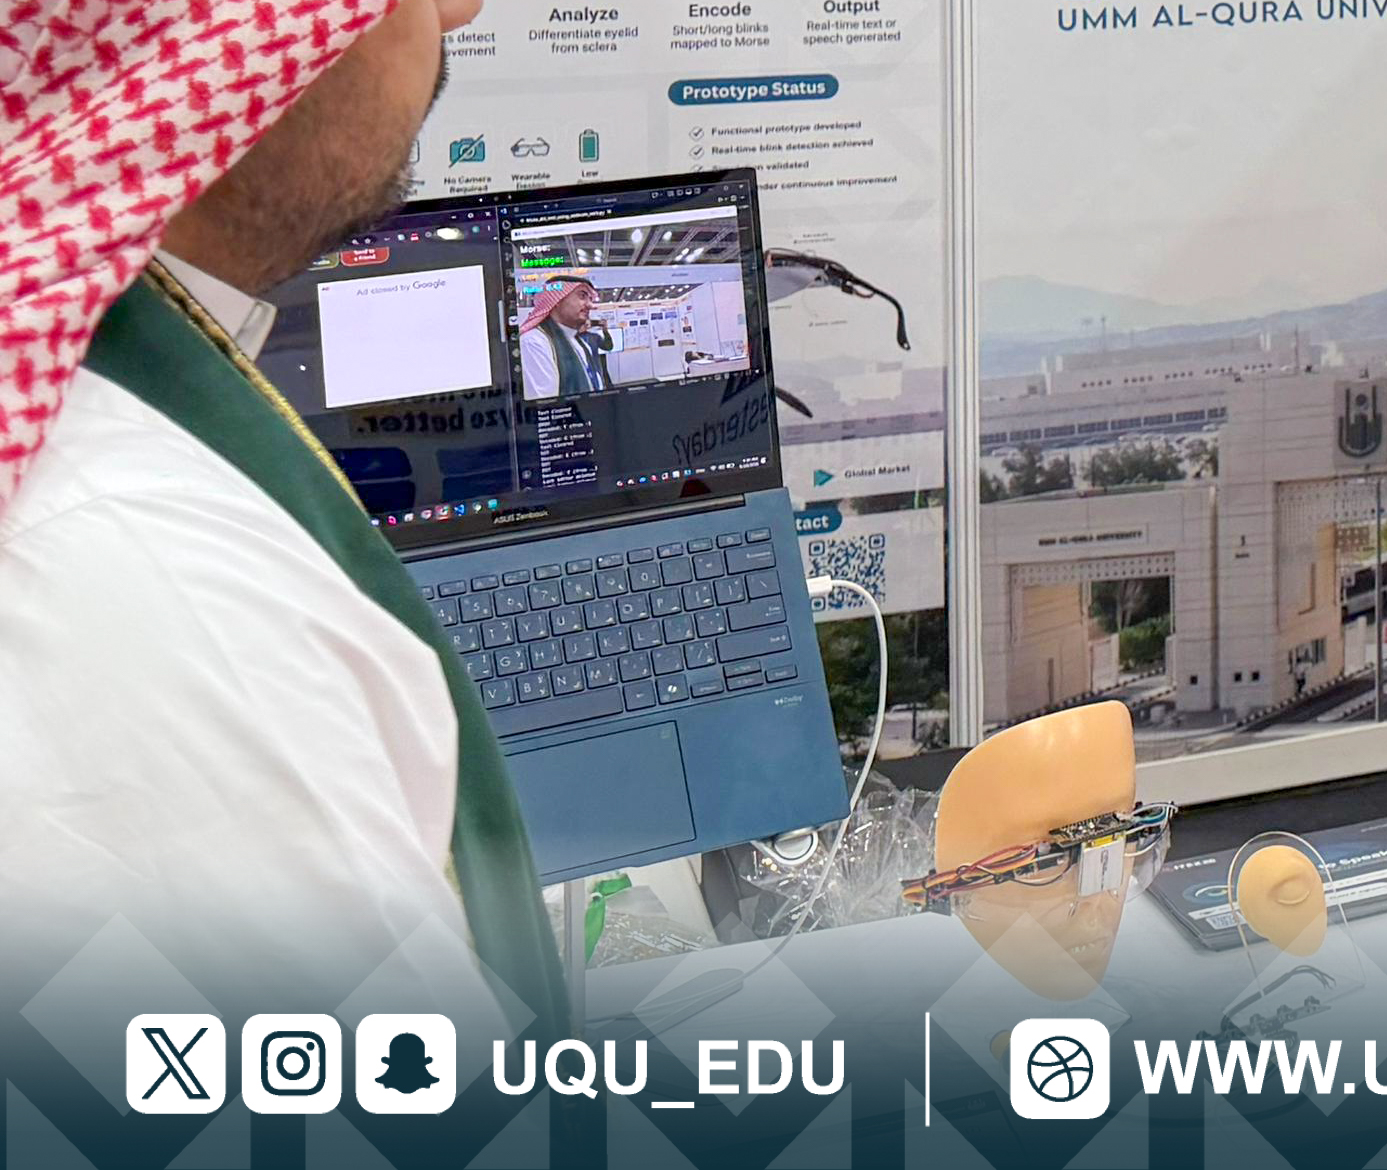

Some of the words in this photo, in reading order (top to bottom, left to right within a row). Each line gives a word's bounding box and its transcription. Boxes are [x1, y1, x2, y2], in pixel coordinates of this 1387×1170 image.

[549, 6, 619, 24] Analyze
[689, 2, 751, 17] Encode
[823, 0, 880, 15] Output
[1058, 6, 1137, 31] UMM
[1153, 0, 1303, 28] AL-QURA
[672, 24, 733, 38] Short/long
[735, 23, 769, 34] blinks
[807, 20, 860, 31] Real-time
[862, 20, 883, 30] text
[885, 19, 897, 29] or
[457, 32, 495, 43] detect
[529, 28, 602, 41] Differentiate
[604, 26, 638, 40] eyelid
[803, 32, 843, 46] speech
[845, 31, 901, 45] generated
[551, 42, 579, 53] from
[582, 41, 617, 52] sclera
[670, 37, 717, 50] mapped
[720, 36, 732, 48] to
[735, 36, 770, 47] Morse
[682, 84, 769, 101] Prototype
[771, 81, 826, 97] Status
[413, 278, 446, 291] Google
[845, 467, 877, 479] Global
[878, 464, 910, 477] Market
[796, 515, 830, 531] tact
